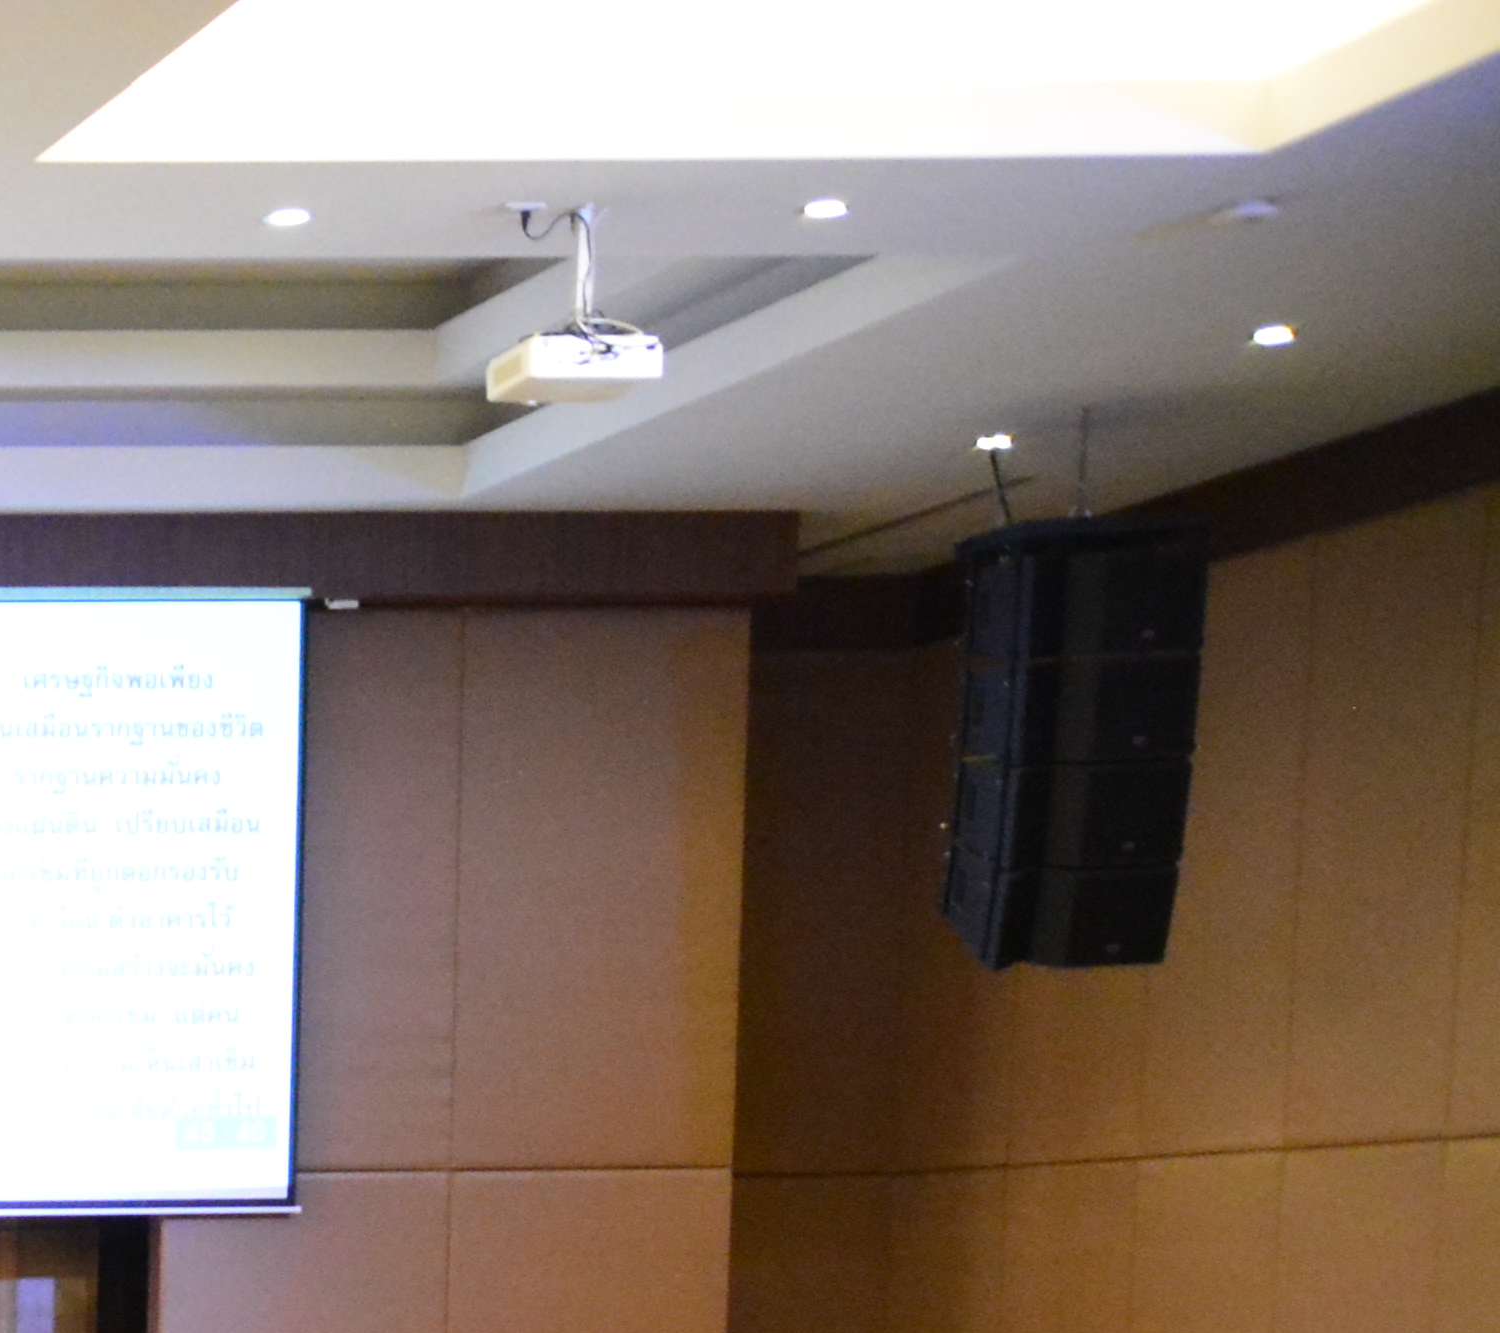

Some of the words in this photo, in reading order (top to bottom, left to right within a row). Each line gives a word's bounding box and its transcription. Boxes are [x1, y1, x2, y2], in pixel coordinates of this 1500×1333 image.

[23, 664, 214, 697] เศรษฐกิจพอเพียง
